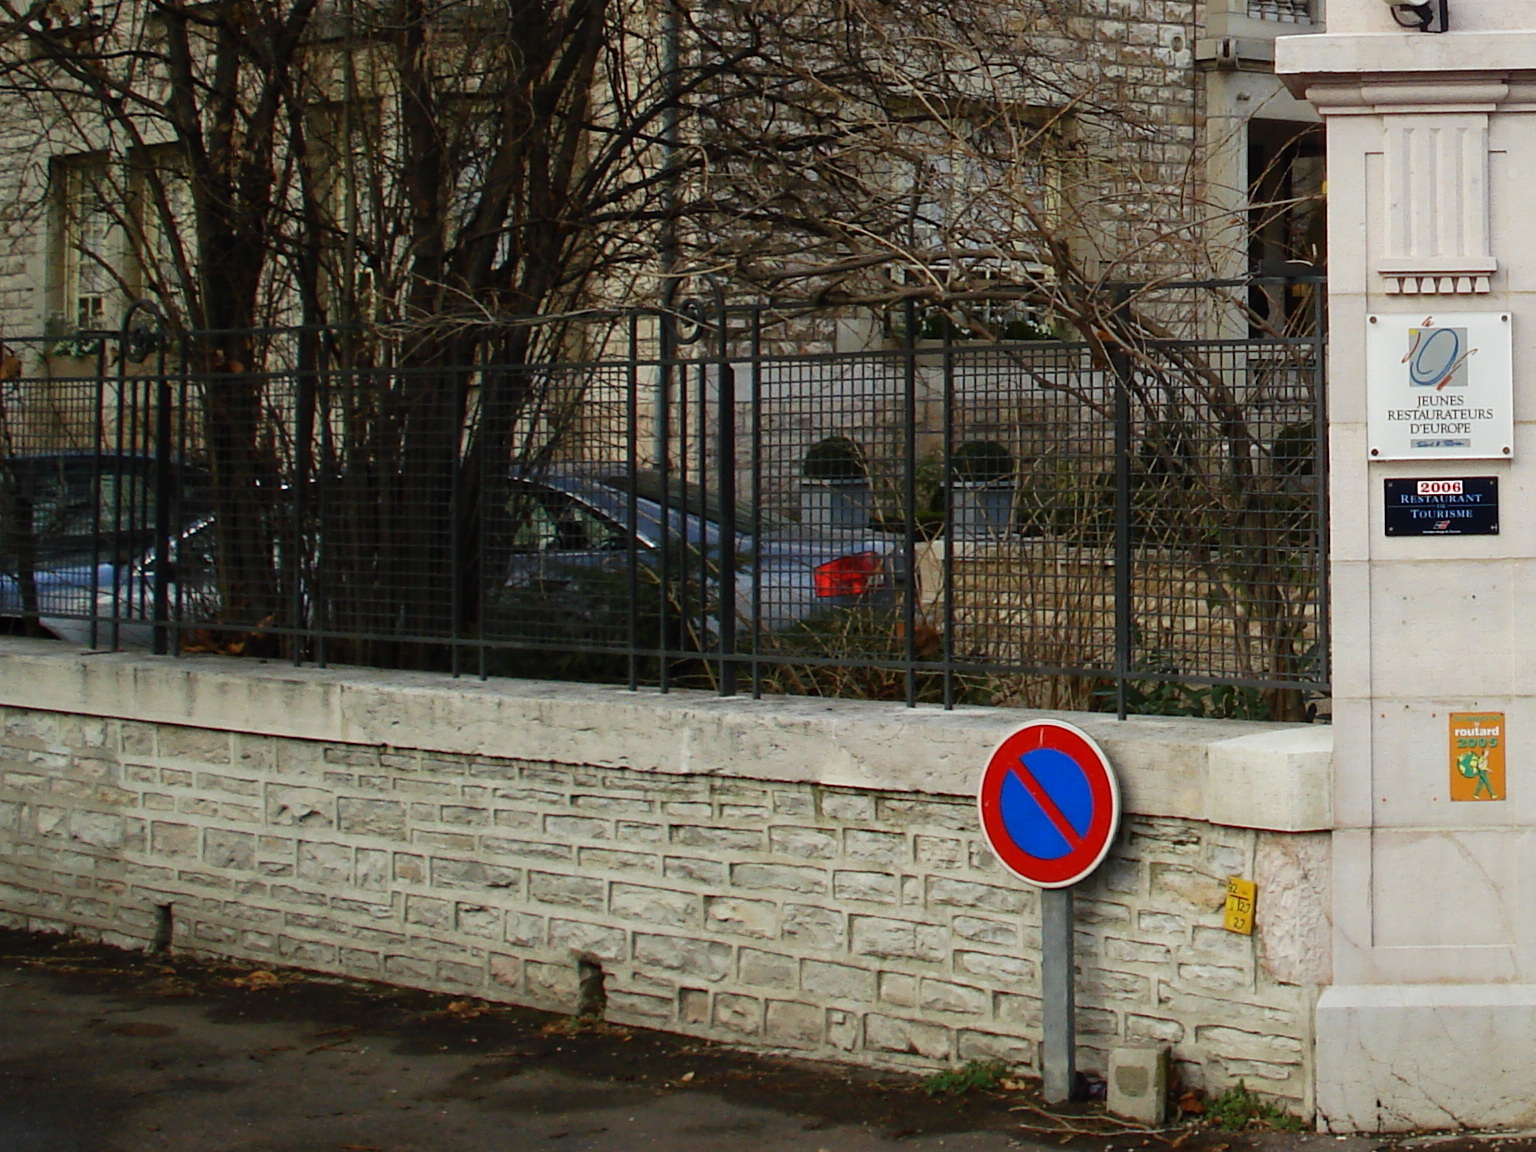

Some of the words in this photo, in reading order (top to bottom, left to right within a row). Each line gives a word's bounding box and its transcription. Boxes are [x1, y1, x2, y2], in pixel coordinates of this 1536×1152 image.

[1417, 395, 1464, 408] JEUNES
[1388, 409, 1494, 421] RESTAURATEURS
[1410, 423, 1471, 434] D'EUROPE
[1420, 482, 1462, 493] 2006
[1401, 494, 1483, 504] RESTAURANT
[1410, 509, 1473, 519] TOURISME
[1454, 725, 1500, 737] routard
[1456, 737, 1499, 748] 2005
